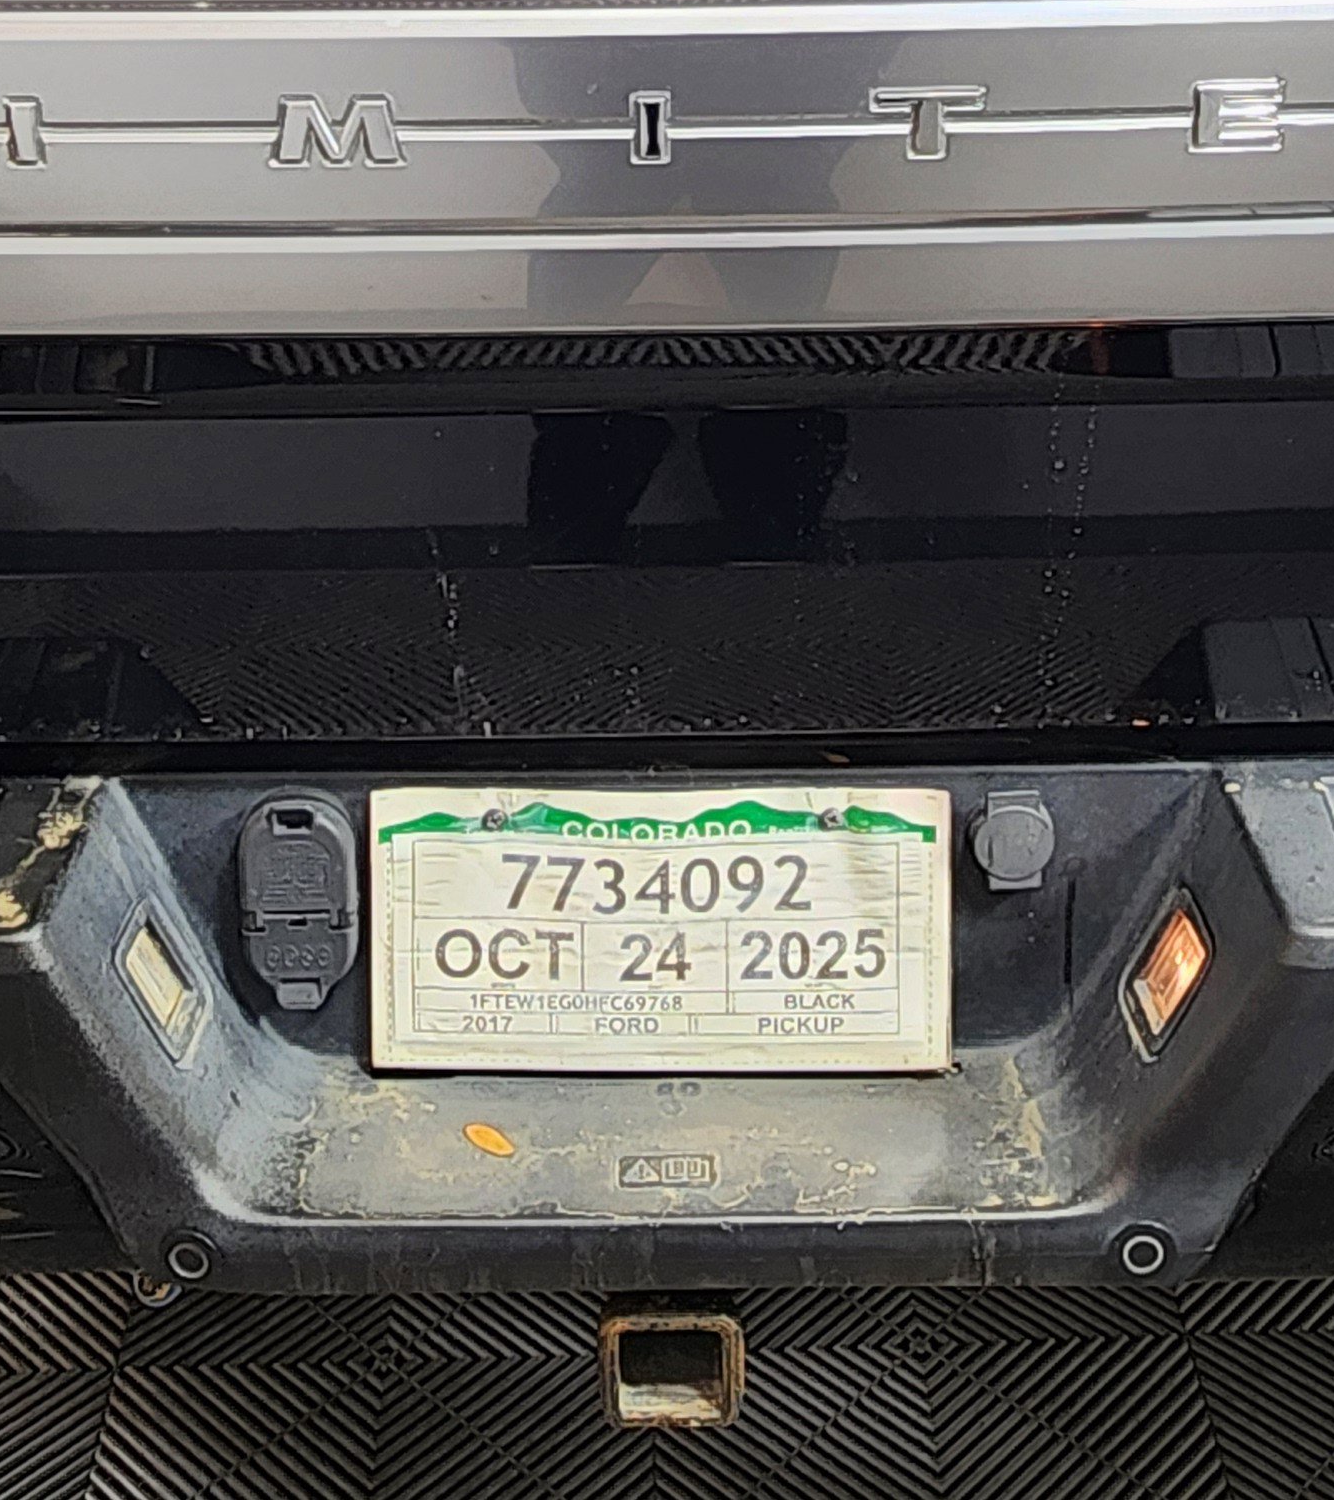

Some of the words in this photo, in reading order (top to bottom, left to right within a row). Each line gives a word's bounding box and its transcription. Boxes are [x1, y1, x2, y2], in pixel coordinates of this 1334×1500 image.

[502, 853, 812, 915] 7734092
[435, 928, 574, 979] OCT
[620, 930, 692, 982] 24
[740, 928, 886, 980] 2025
[470, 994, 683, 1011] 1FTEW1EG0HFC69768
[784, 994, 856, 1010] BLACK
[462, 1016, 513, 1032] 2017
[594, 1017, 659, 1034] FORD
[757, 1017, 844, 1034] PICKUP
